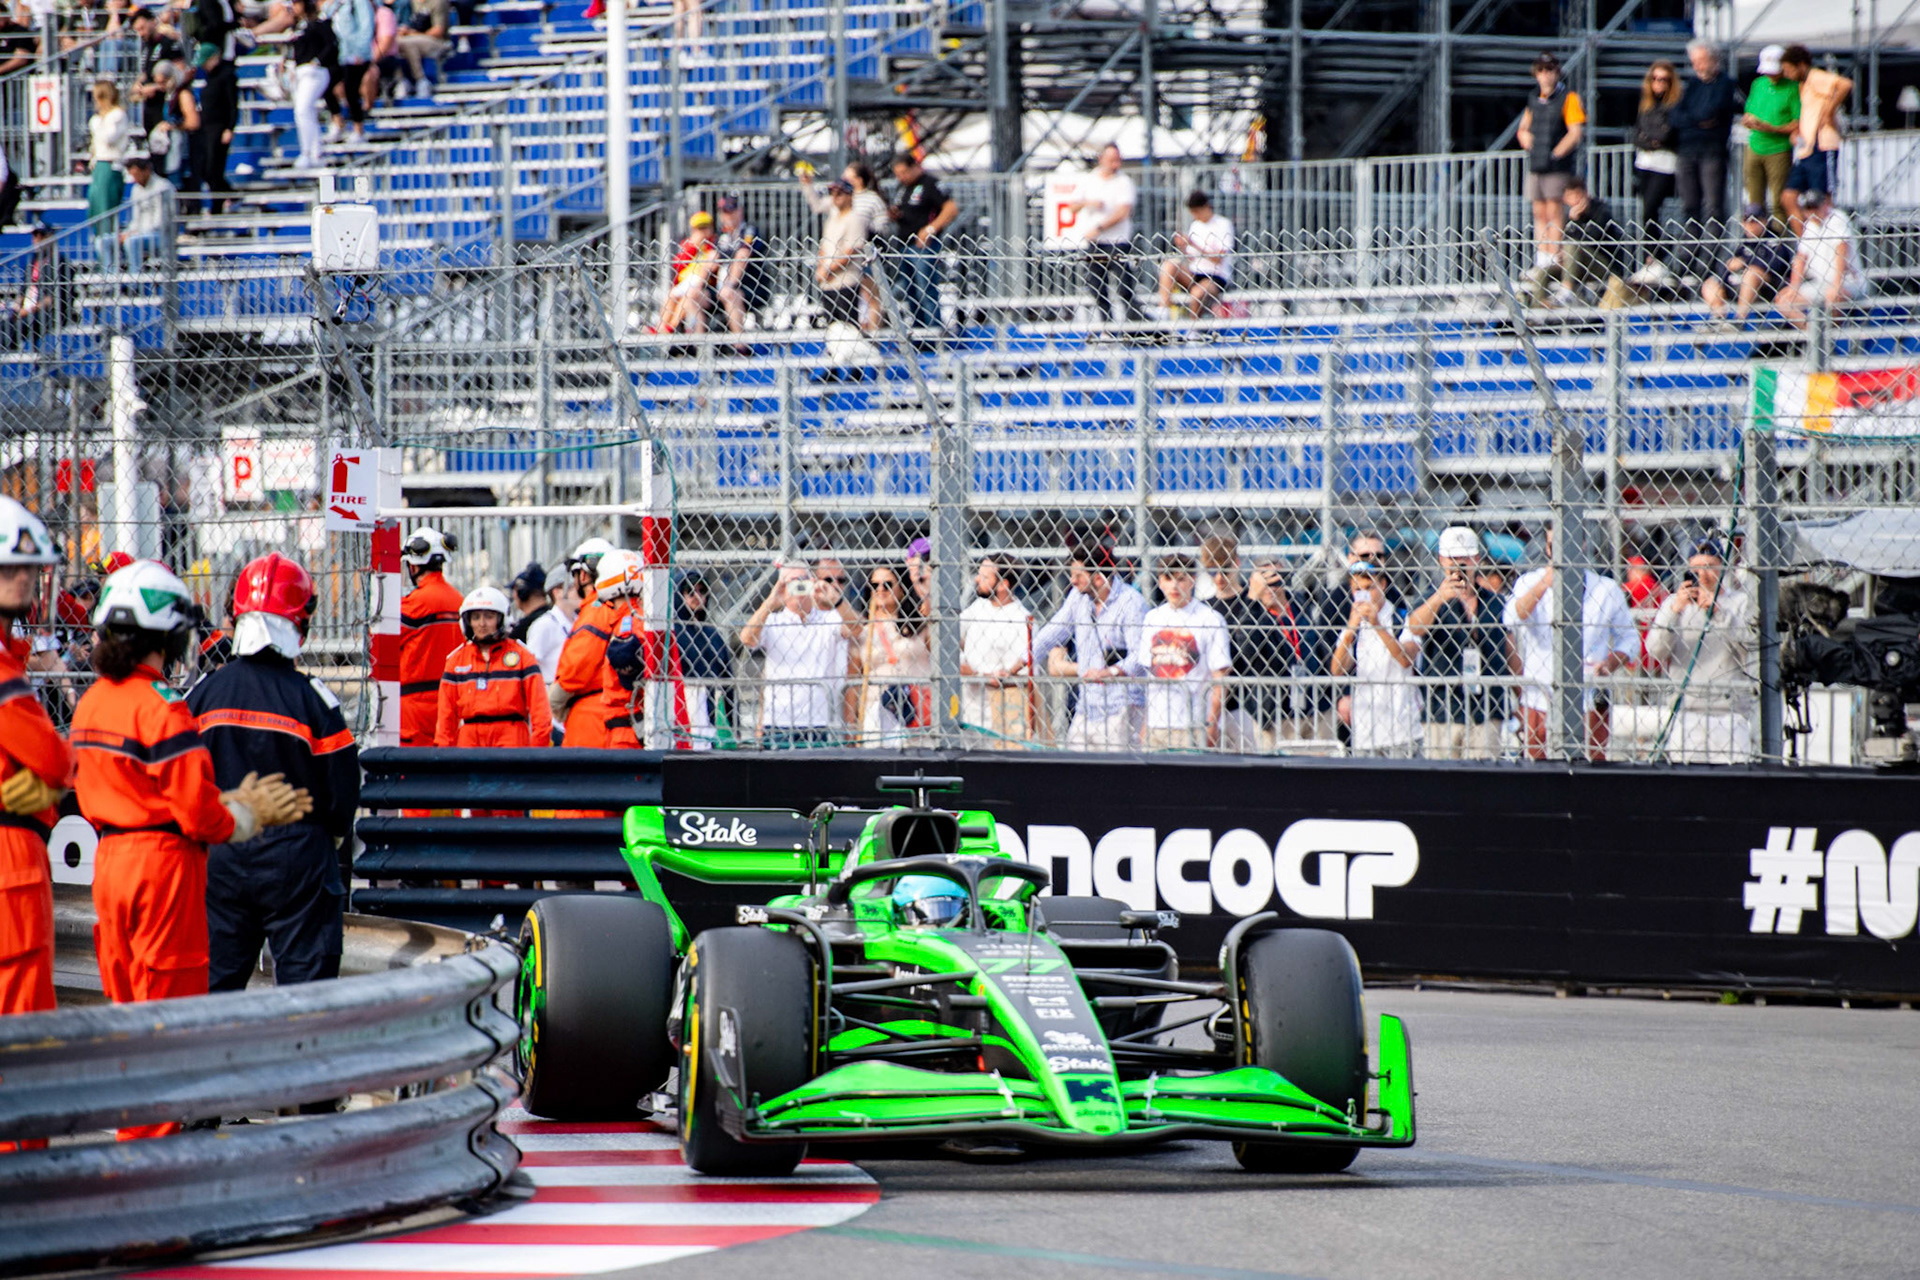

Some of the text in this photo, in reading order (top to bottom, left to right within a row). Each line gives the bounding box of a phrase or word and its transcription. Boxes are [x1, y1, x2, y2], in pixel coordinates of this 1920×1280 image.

[234, 455, 252, 489] P
[331, 495, 367, 505] FIRE
[679, 811, 757, 846] Stake
[978, 958, 1065, 974] 77
